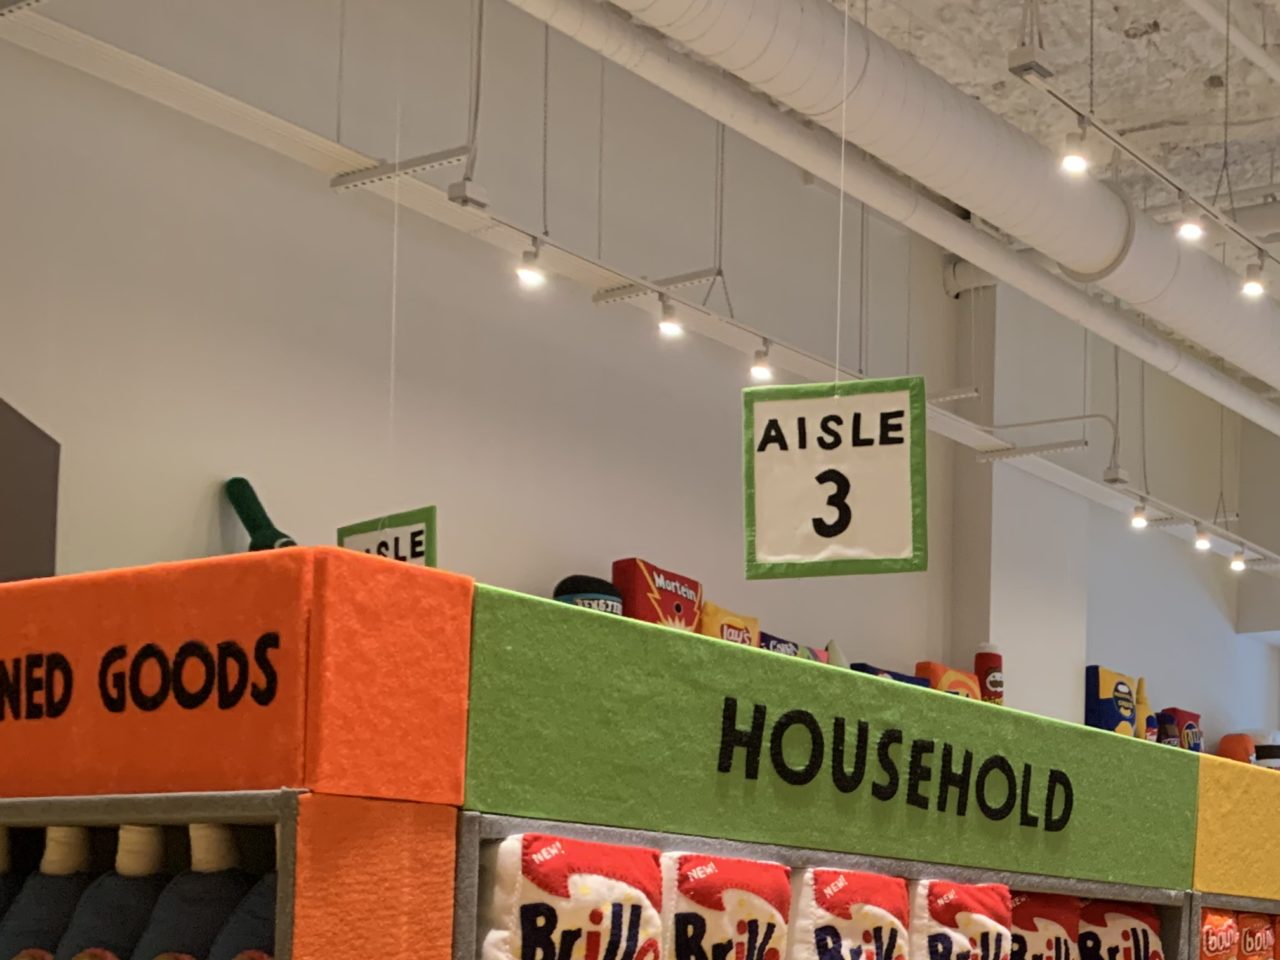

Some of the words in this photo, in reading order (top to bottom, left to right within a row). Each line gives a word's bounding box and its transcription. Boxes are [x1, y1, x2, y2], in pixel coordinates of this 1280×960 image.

[756, 411, 905, 452] AISLE
[812, 469, 853, 539] 3
[365, 529, 425, 561] SLE
[653, 572, 697, 600] Mortein
[98, 631, 281, 713] GOODS
[717, 697, 1074, 832] HOUSEHOLD
[532, 842, 566, 864] NEW!
[687, 861, 718, 882] NEW!
[823, 875, 850, 899] NEW!
